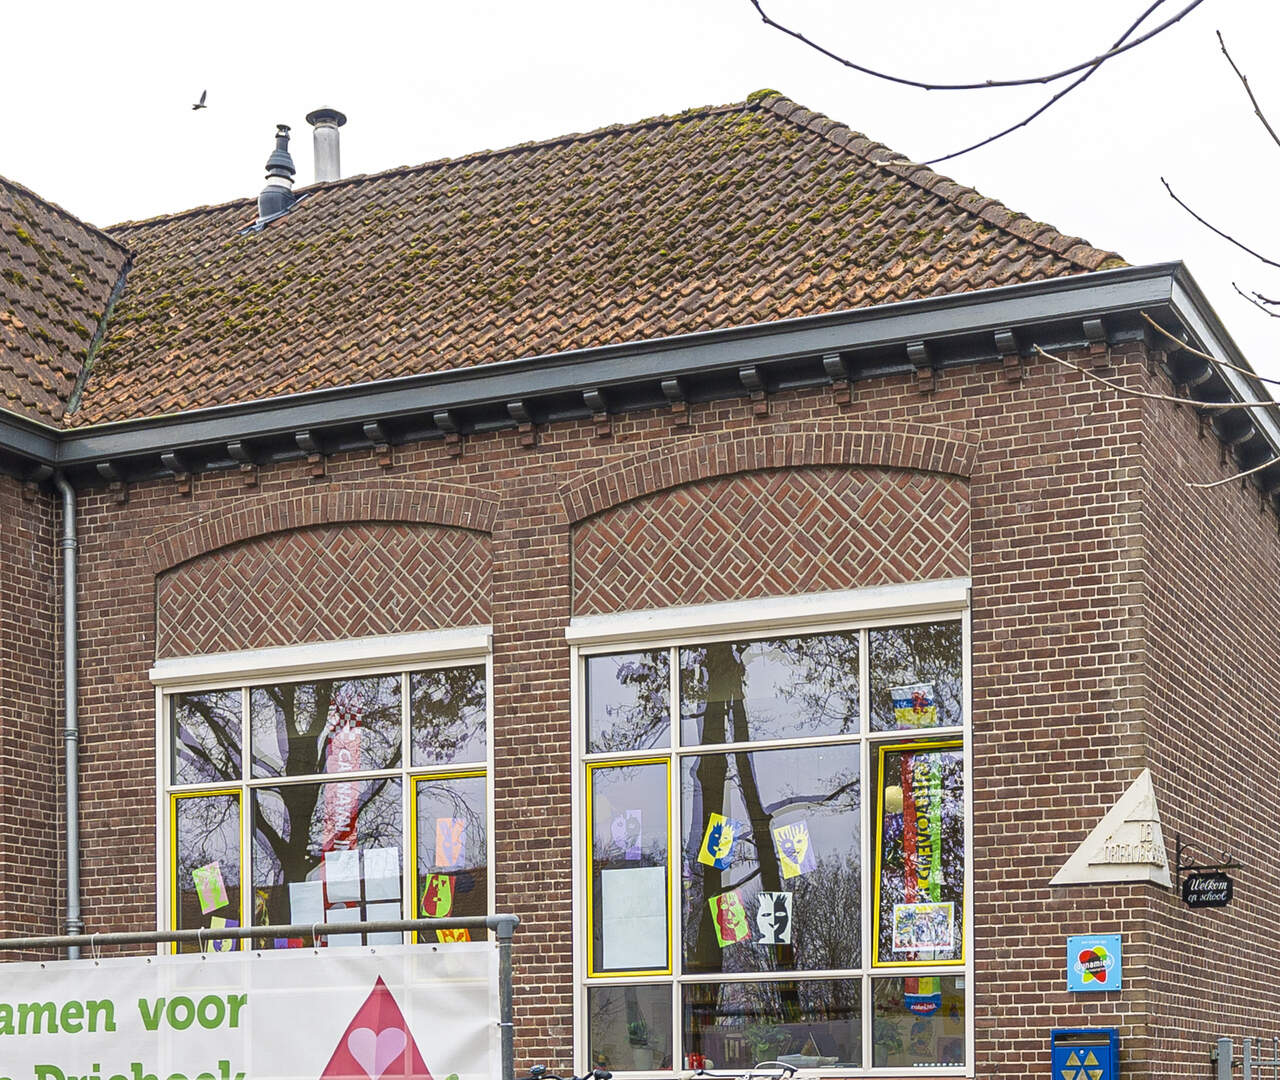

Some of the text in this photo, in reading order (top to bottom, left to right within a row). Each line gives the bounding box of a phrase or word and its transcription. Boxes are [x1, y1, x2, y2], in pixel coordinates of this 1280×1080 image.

[335, 749, 353, 833] CANAVAL
[1188, 890, 1228, 903] op school
[1189, 878, 1228, 890] Welkom
[138, 993, 248, 1031] voor
